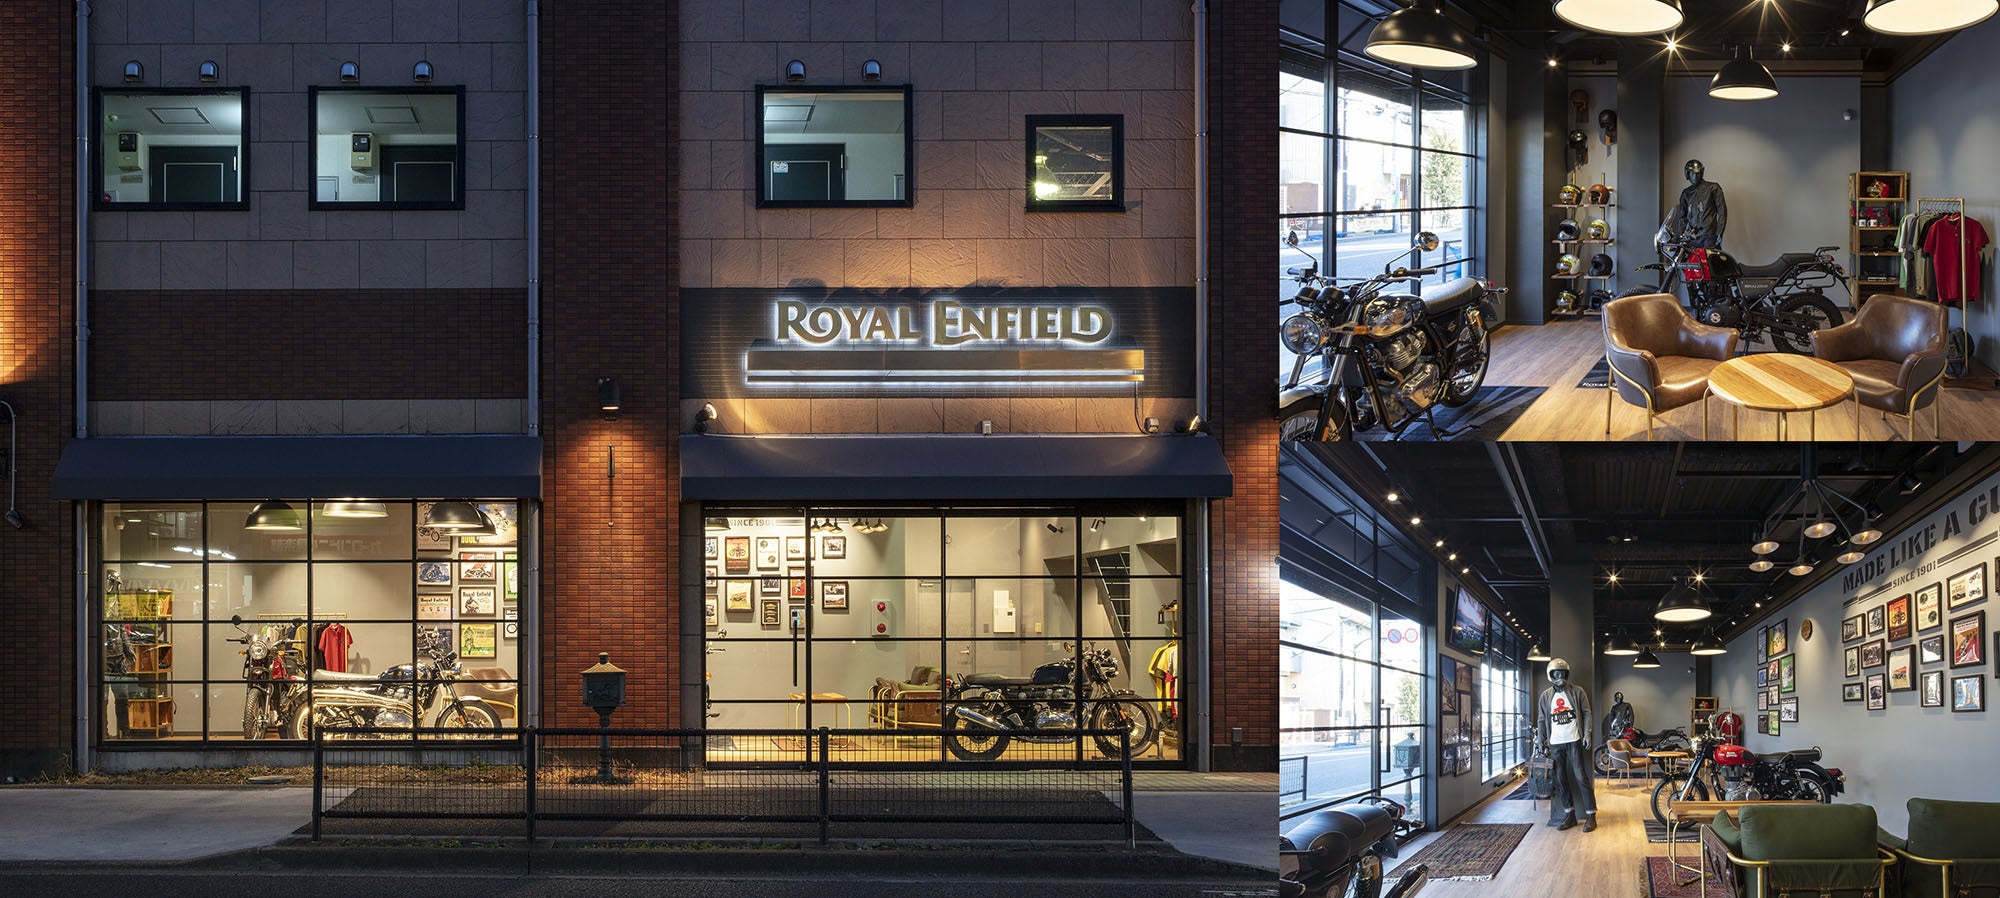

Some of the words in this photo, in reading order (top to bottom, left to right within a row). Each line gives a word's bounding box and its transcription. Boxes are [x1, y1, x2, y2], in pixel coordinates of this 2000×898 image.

[776, 300, 921, 345] ROYAL
[932, 300, 1114, 346] ENFIELD
[729, 519, 754, 527] SINCE
[755, 519, 775, 527] 1901
[1843, 554, 1886, 594] MADE
[1890, 523, 1937, 569] LIKE
[1942, 510, 1961, 542] A
[1892, 572, 1916, 588] SINCE
[1917, 561, 1937, 577] 1901
